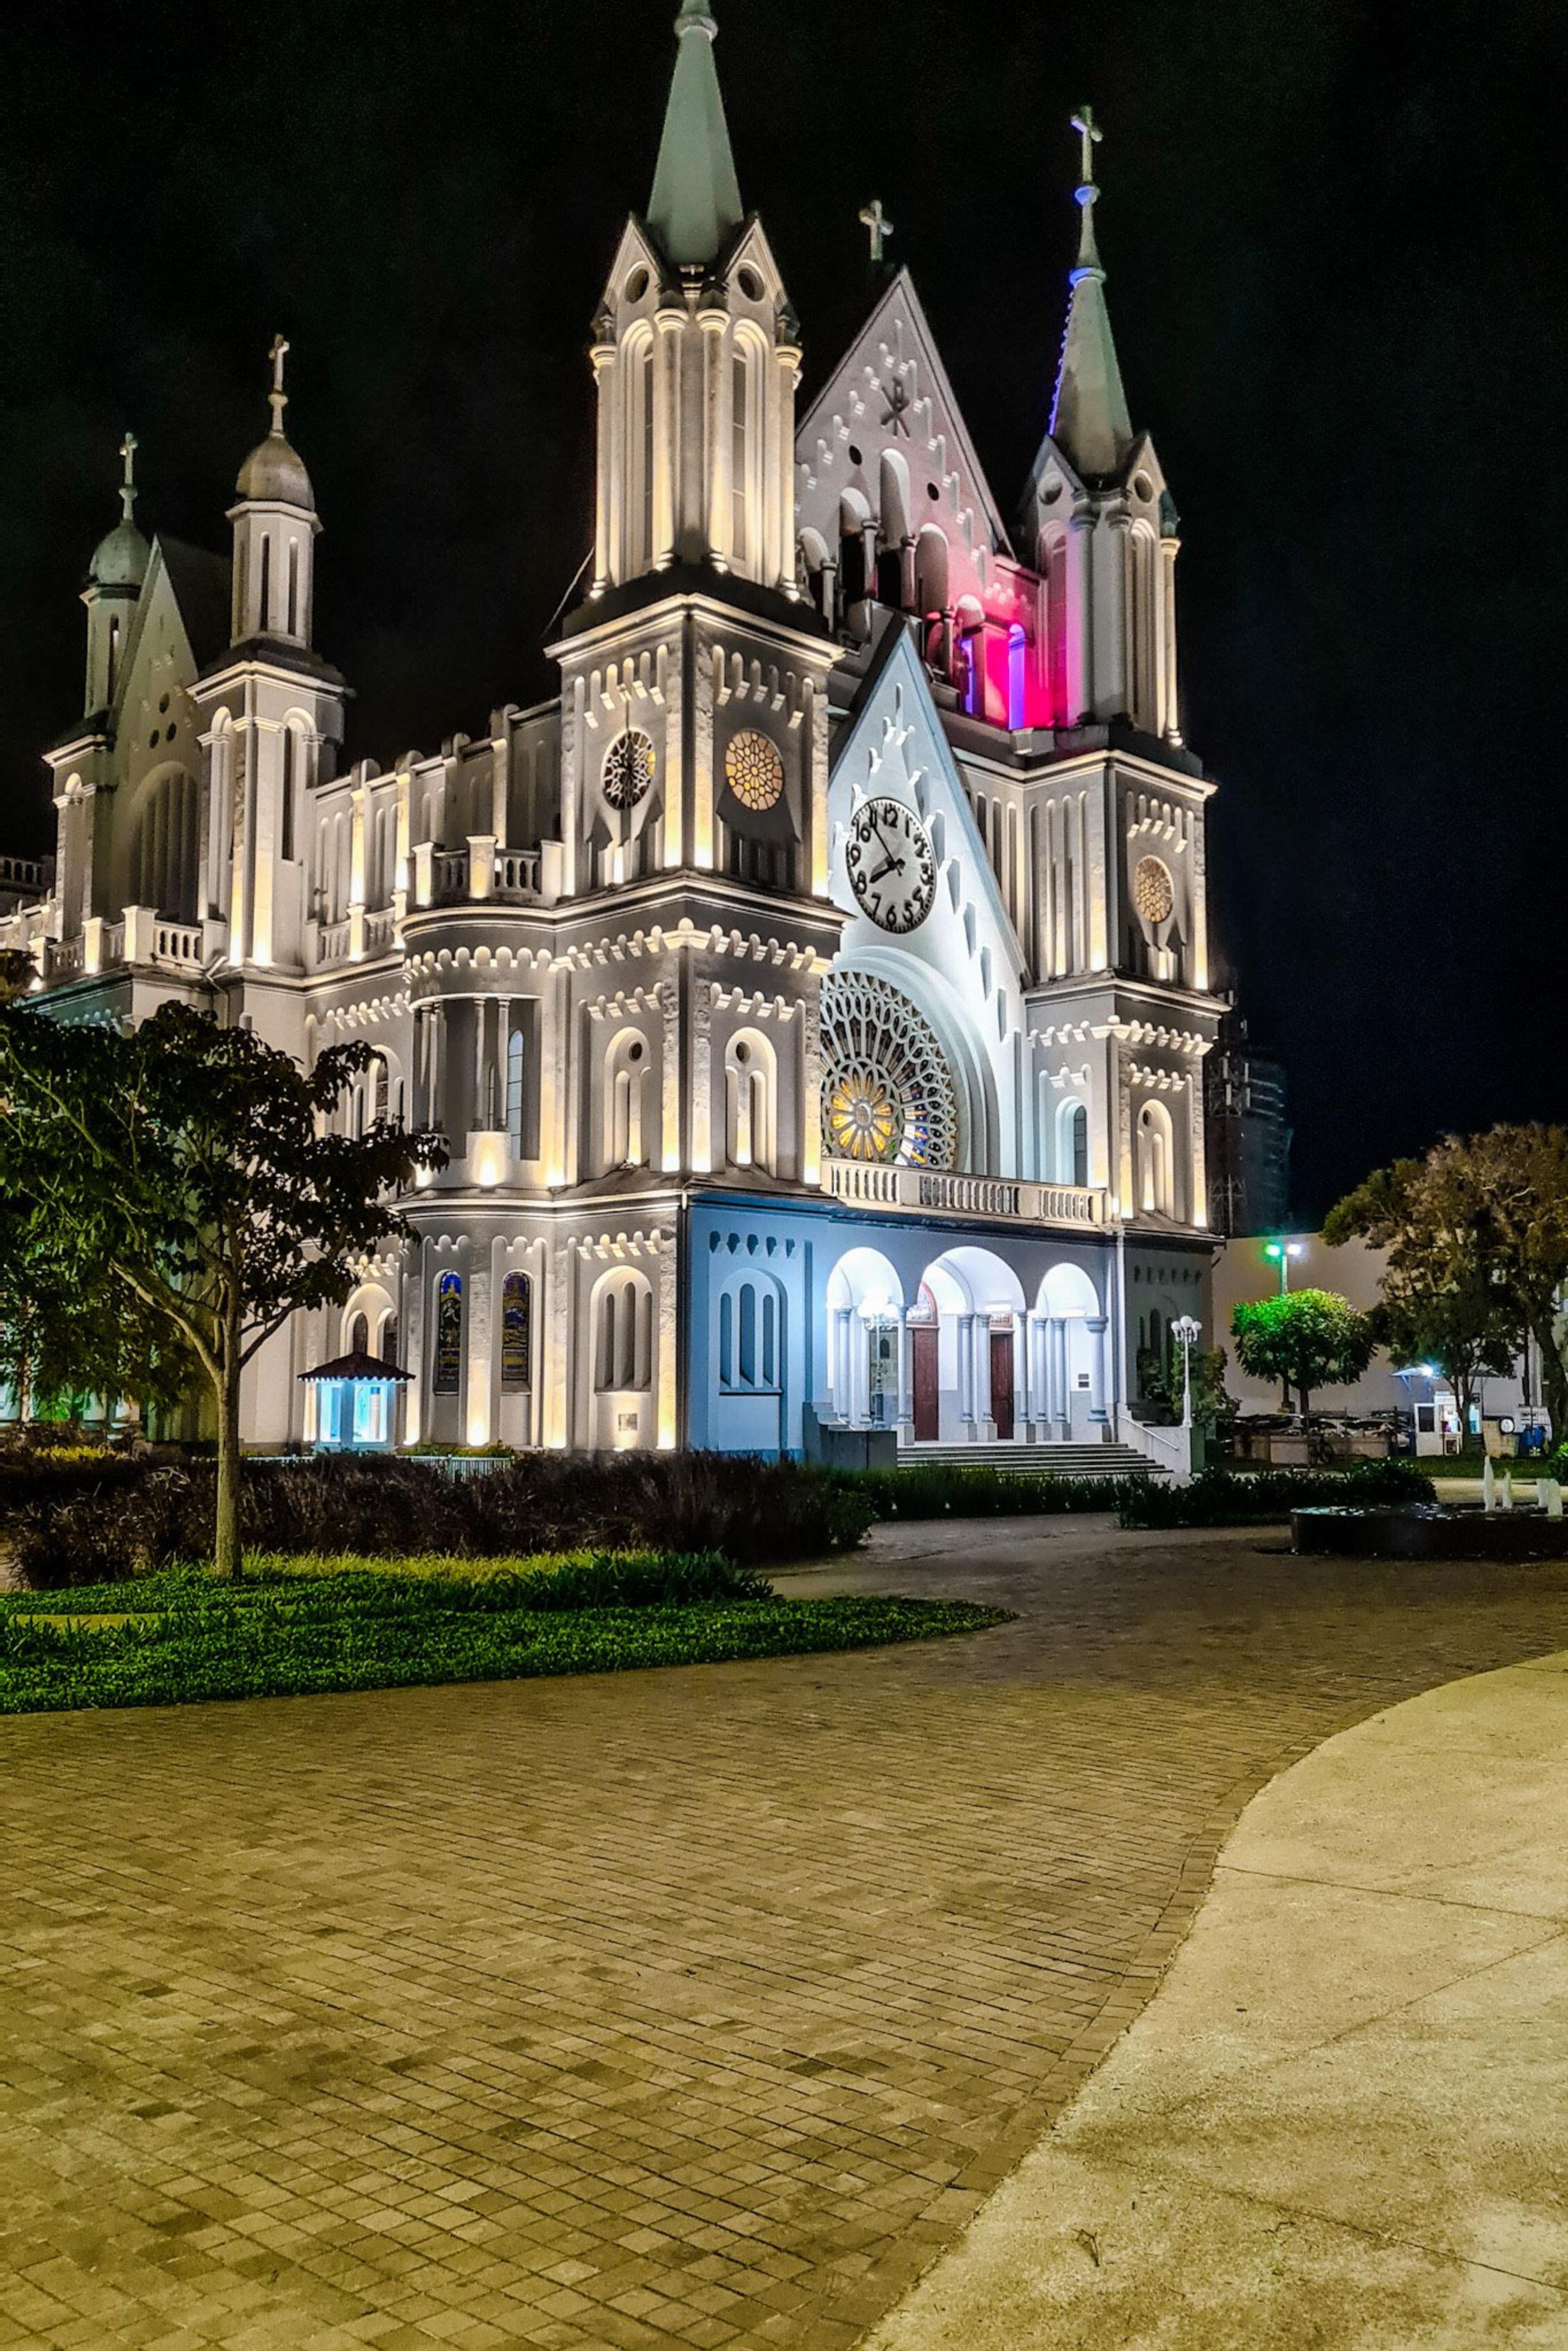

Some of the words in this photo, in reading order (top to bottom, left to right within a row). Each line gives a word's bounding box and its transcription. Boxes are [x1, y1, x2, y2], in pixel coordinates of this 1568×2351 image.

[884, 805, 898, 828] 12
[906, 814, 909, 838] 1
[856, 817, 871, 843] 10
[851, 844, 861, 867] 9
[913, 833, 926, 858] 2
[857, 870, 867, 895] 8
[920, 862, 933, 885] 3
[871, 892, 881, 919] 7
[912, 886, 923, 909] 4
[886, 905, 897, 925] 6
[902, 900, 913, 923] 5
